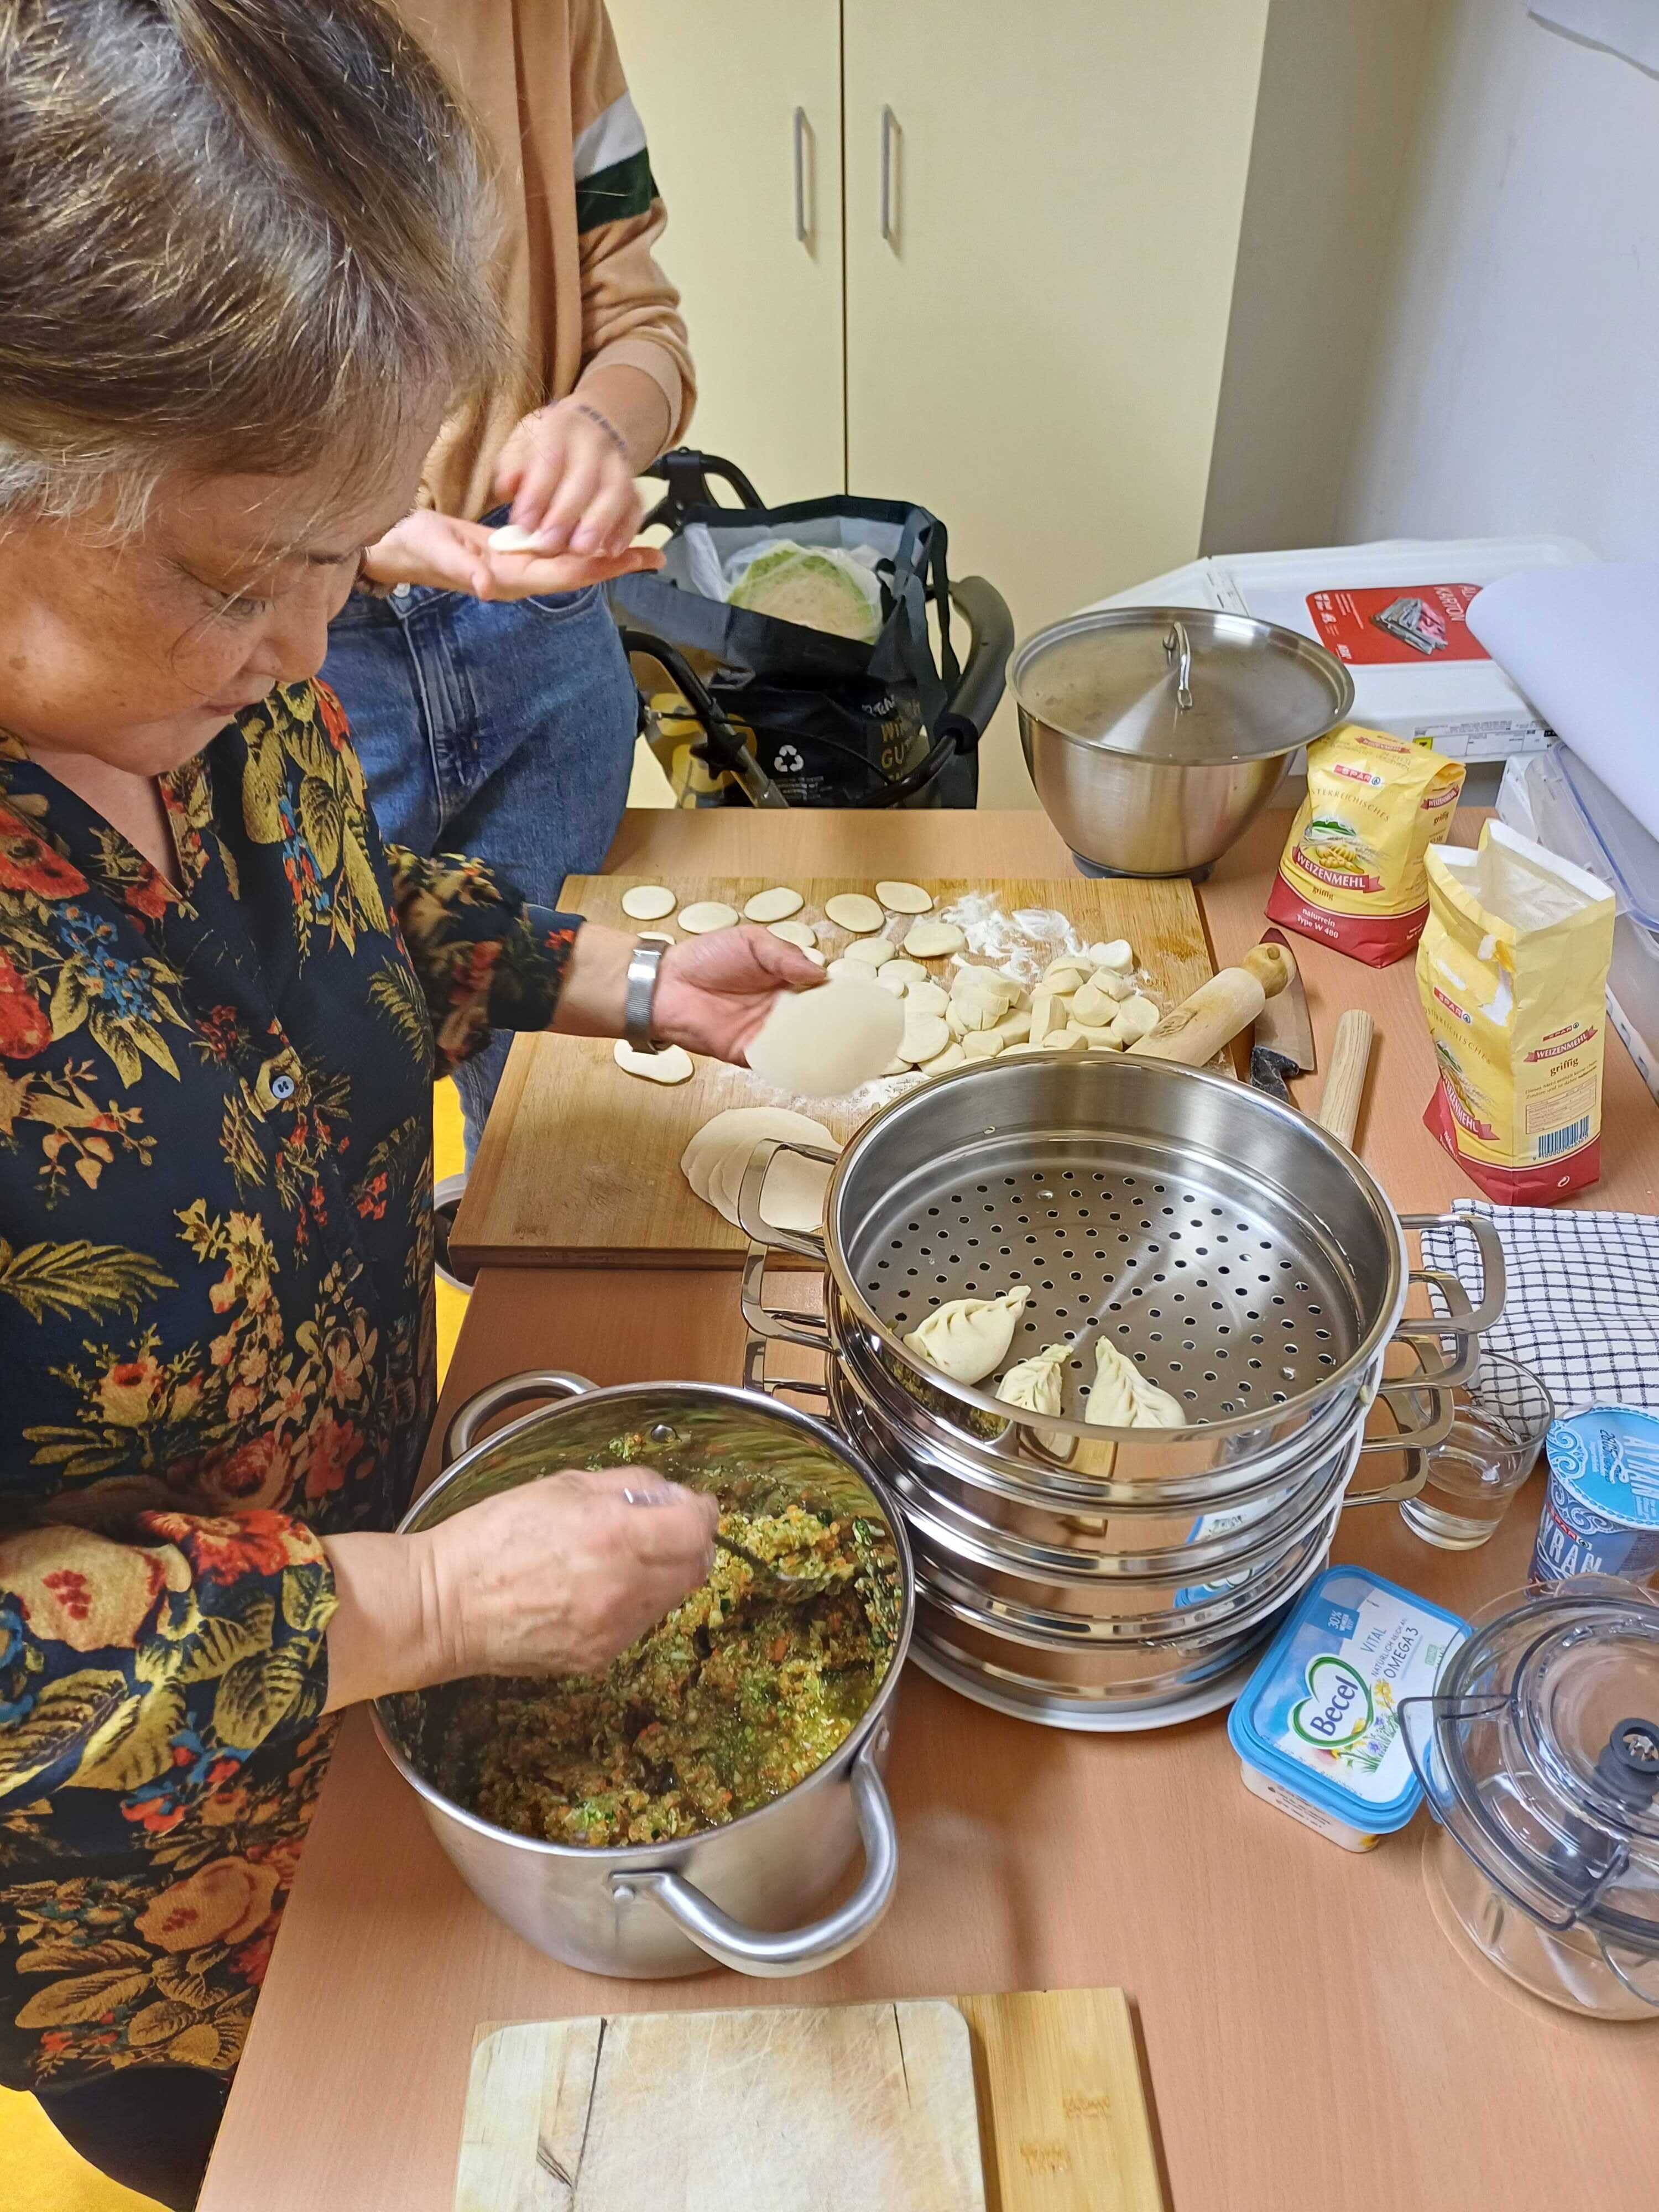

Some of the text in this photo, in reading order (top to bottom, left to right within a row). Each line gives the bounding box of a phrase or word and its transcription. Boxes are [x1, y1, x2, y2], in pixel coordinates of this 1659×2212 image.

[1433, 587, 1465, 622] KARTON
[1341, 767, 1371, 783] SPAR
[1297, 851, 1365, 888] WEIZENMEHL
[1312, 886, 1334, 901] griffig
[1297, 914, 1313, 930] Type
[1314, 922, 1323, 932] W
[1302, 908, 1335, 928] naturrein
[1438, 994, 1462, 1019] SPAR
[1536, 1033, 1588, 1058] WEIZENMEHL
[1550, 1058, 1579, 1077] griffig
[1328, 1610, 1343, 1630] 30%
[1360, 1627, 1387, 1653] VITAL
[1383, 1627, 1419, 1679] OMEGA 3
[1310, 1674, 1359, 1737] Becel
